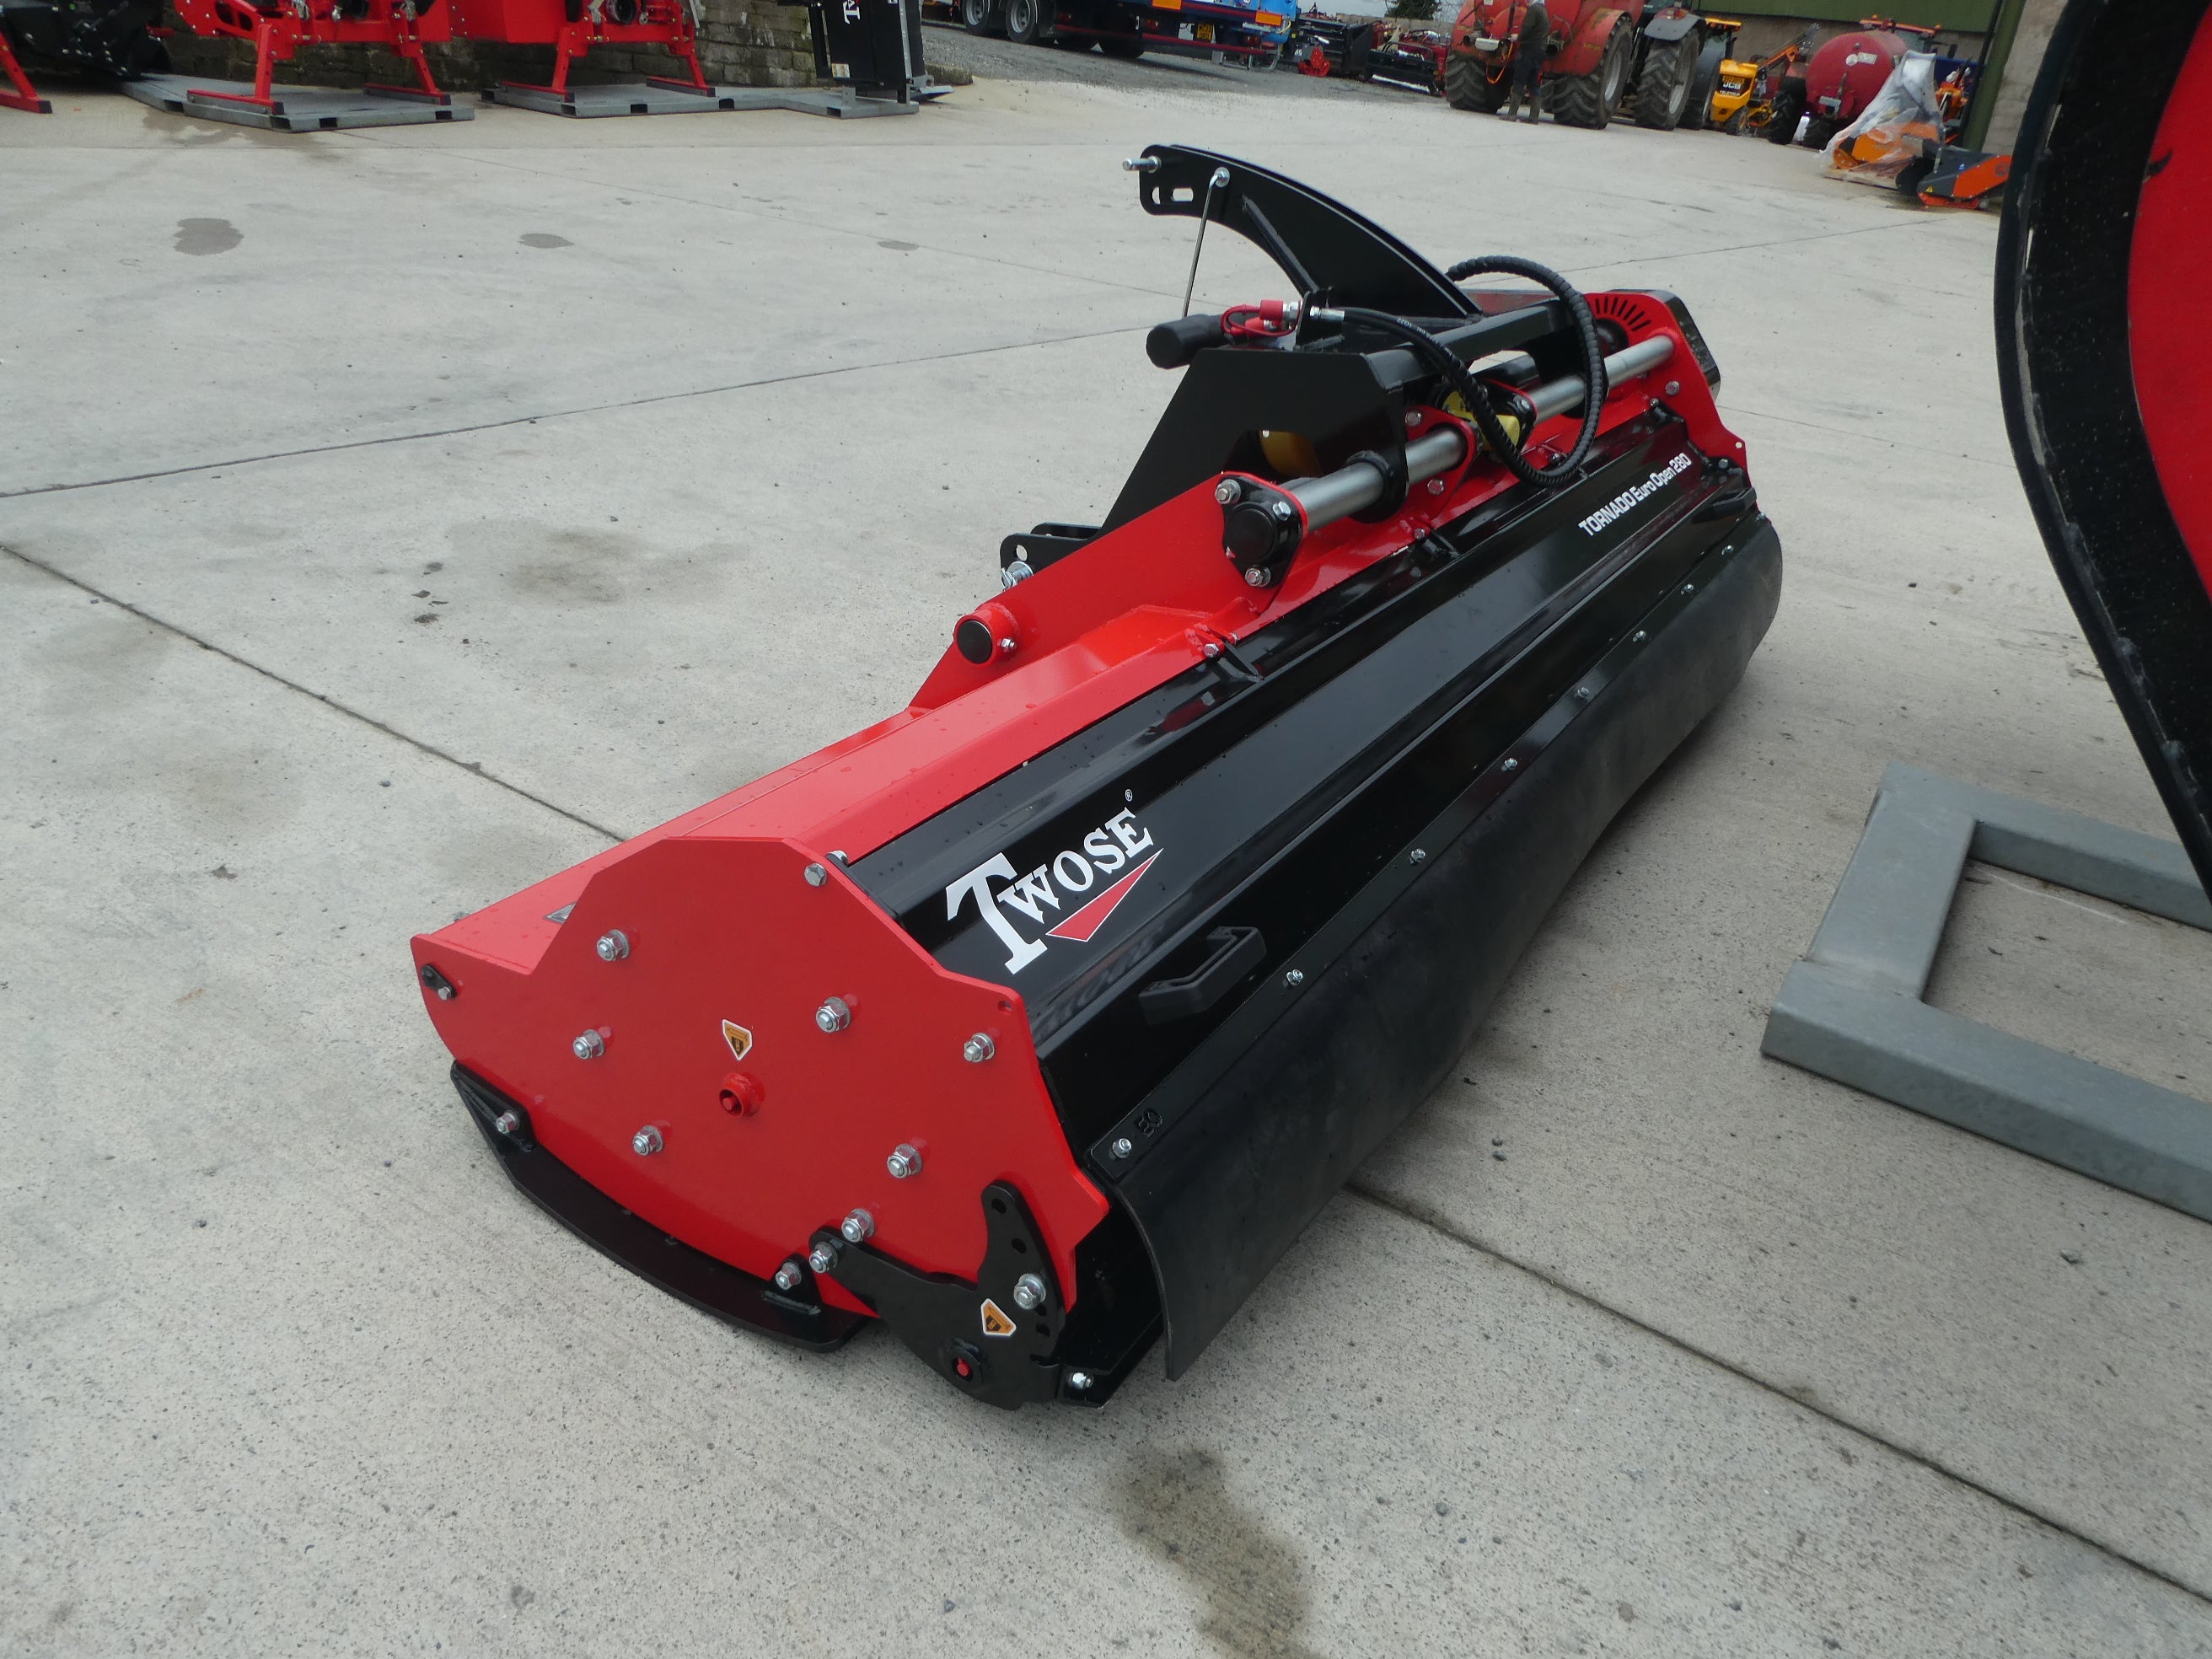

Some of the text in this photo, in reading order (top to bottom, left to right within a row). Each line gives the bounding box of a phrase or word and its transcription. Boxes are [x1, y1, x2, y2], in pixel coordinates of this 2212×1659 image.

[1578, 452, 1692, 536] TORNADO Euro Open 280
[946, 807, 1153, 975] TWOSE
